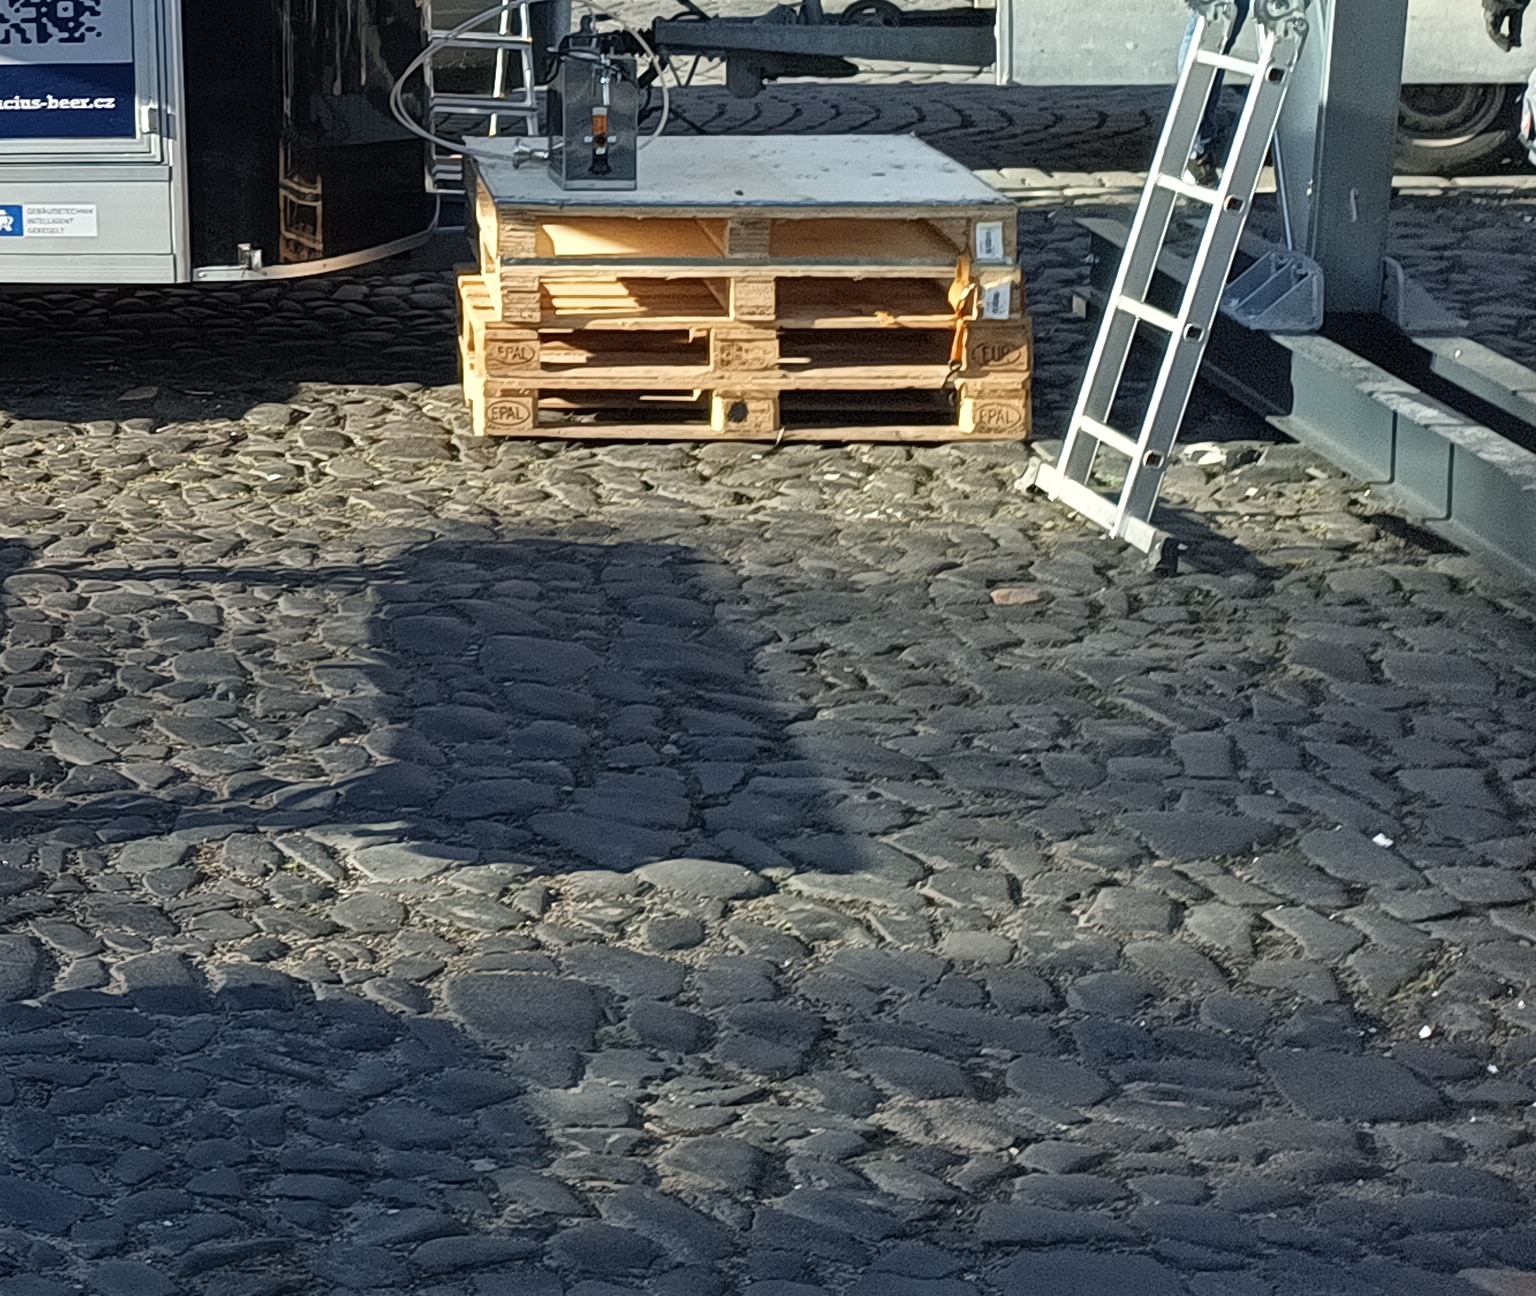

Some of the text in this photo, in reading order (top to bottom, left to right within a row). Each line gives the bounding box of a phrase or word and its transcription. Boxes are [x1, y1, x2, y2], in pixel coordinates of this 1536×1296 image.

[497, 346, 528, 361] EPAL
[491, 407, 525, 421] EPAL
[979, 407, 1017, 425] EPAL
